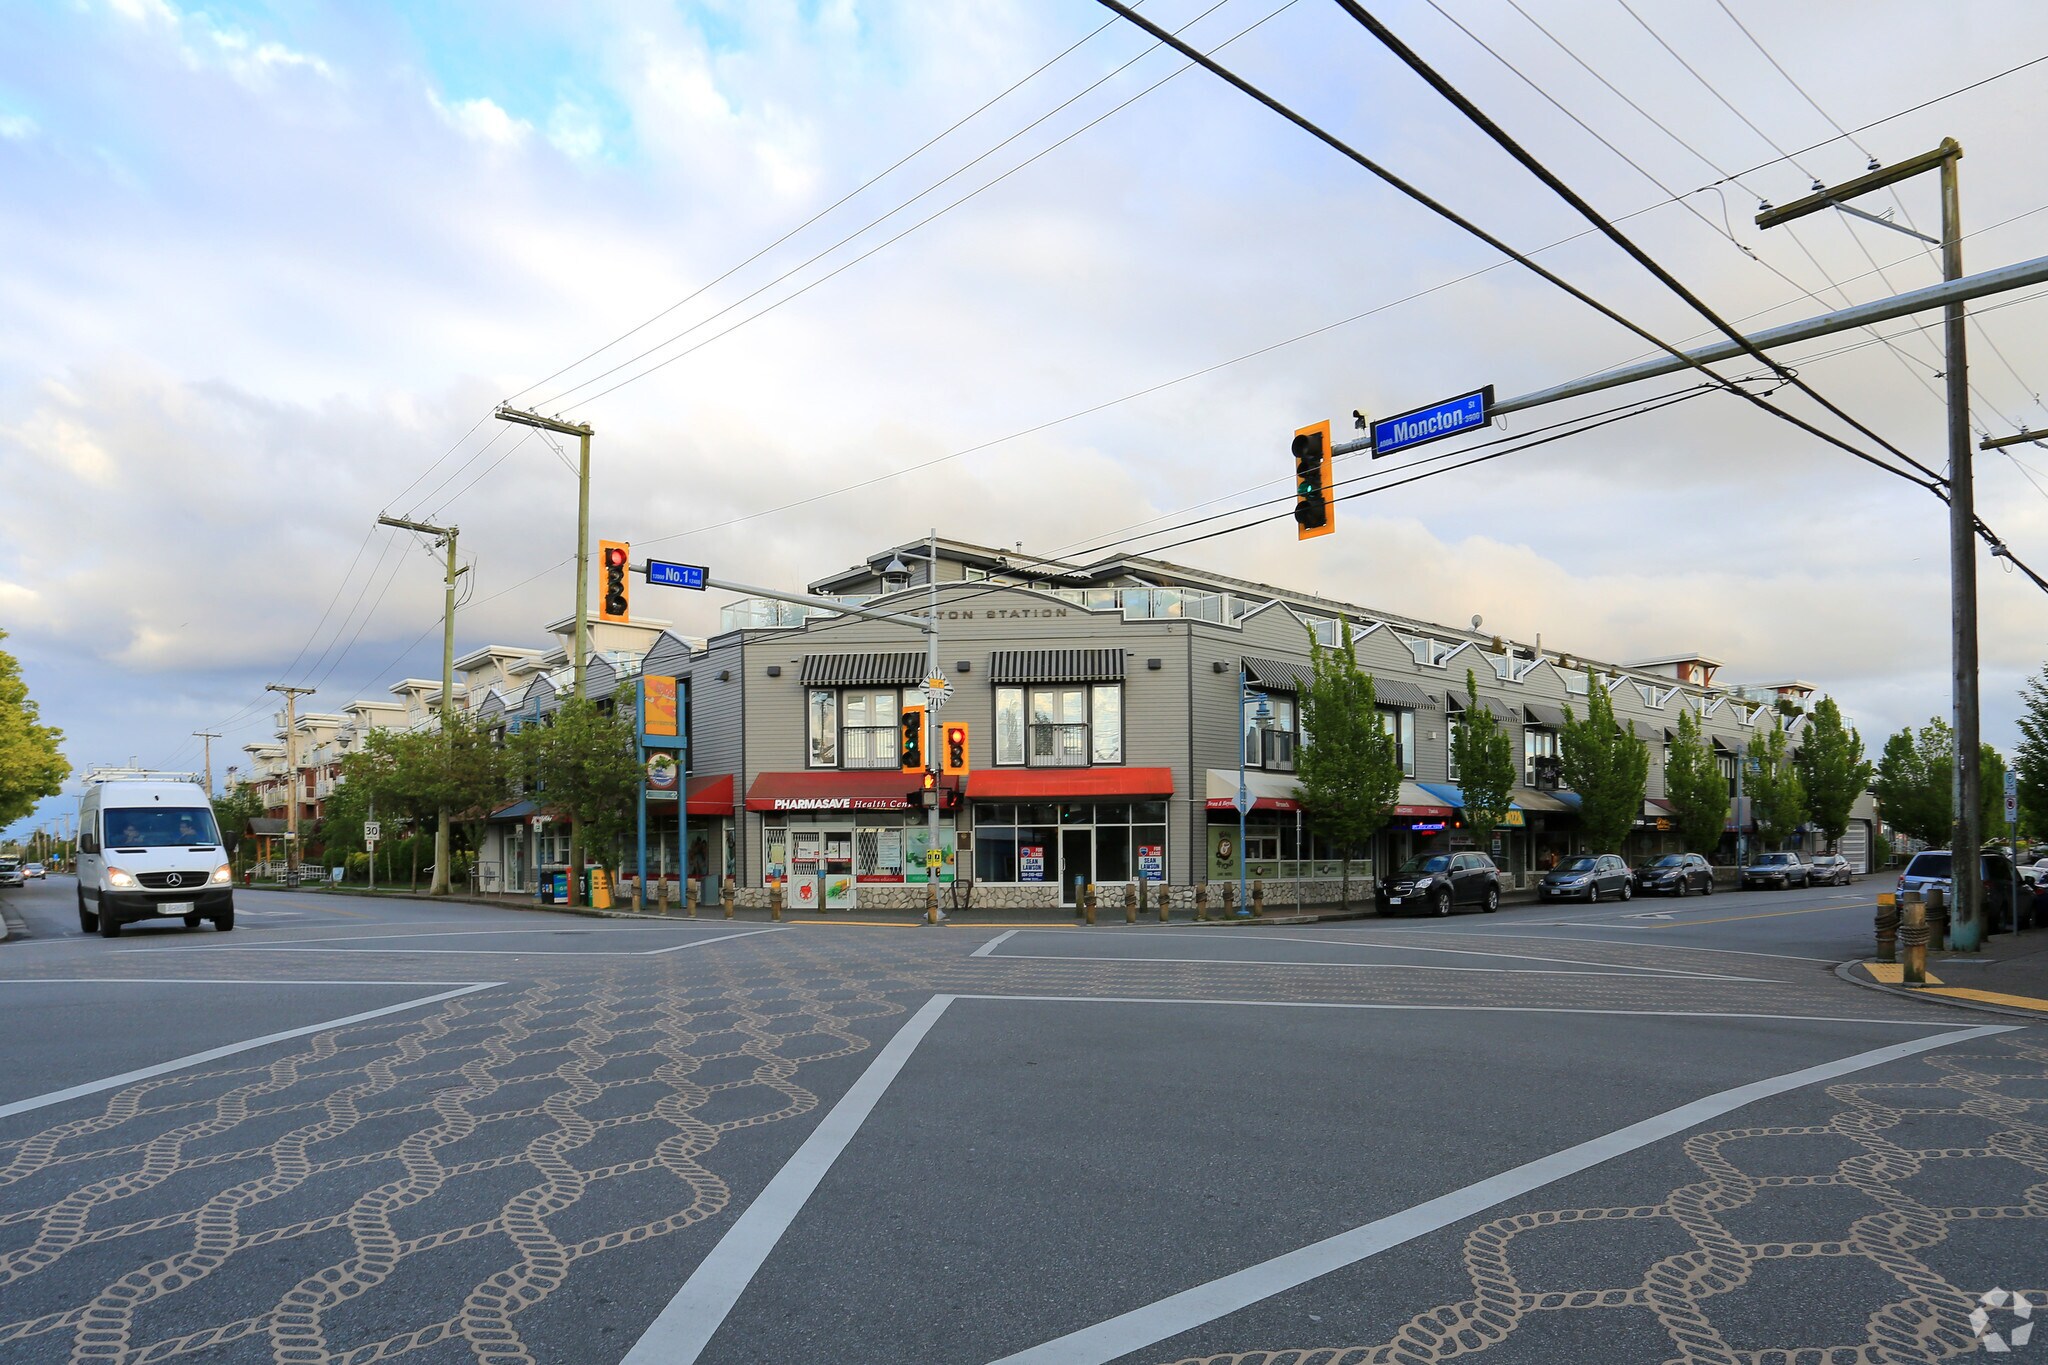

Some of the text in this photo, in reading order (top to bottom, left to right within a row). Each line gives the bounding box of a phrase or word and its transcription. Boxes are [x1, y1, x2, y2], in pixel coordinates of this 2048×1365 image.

[1468, 400, 1475, 409] St
[1393, 409, 1463, 443] Moncton
[665, 568, 688, 583] No.1
[986, 608, 1067, 619] STATION
[774, 798, 851, 810] PHARMASAVE
[853, 799, 887, 808] Health
[366, 826, 378, 836] 30
